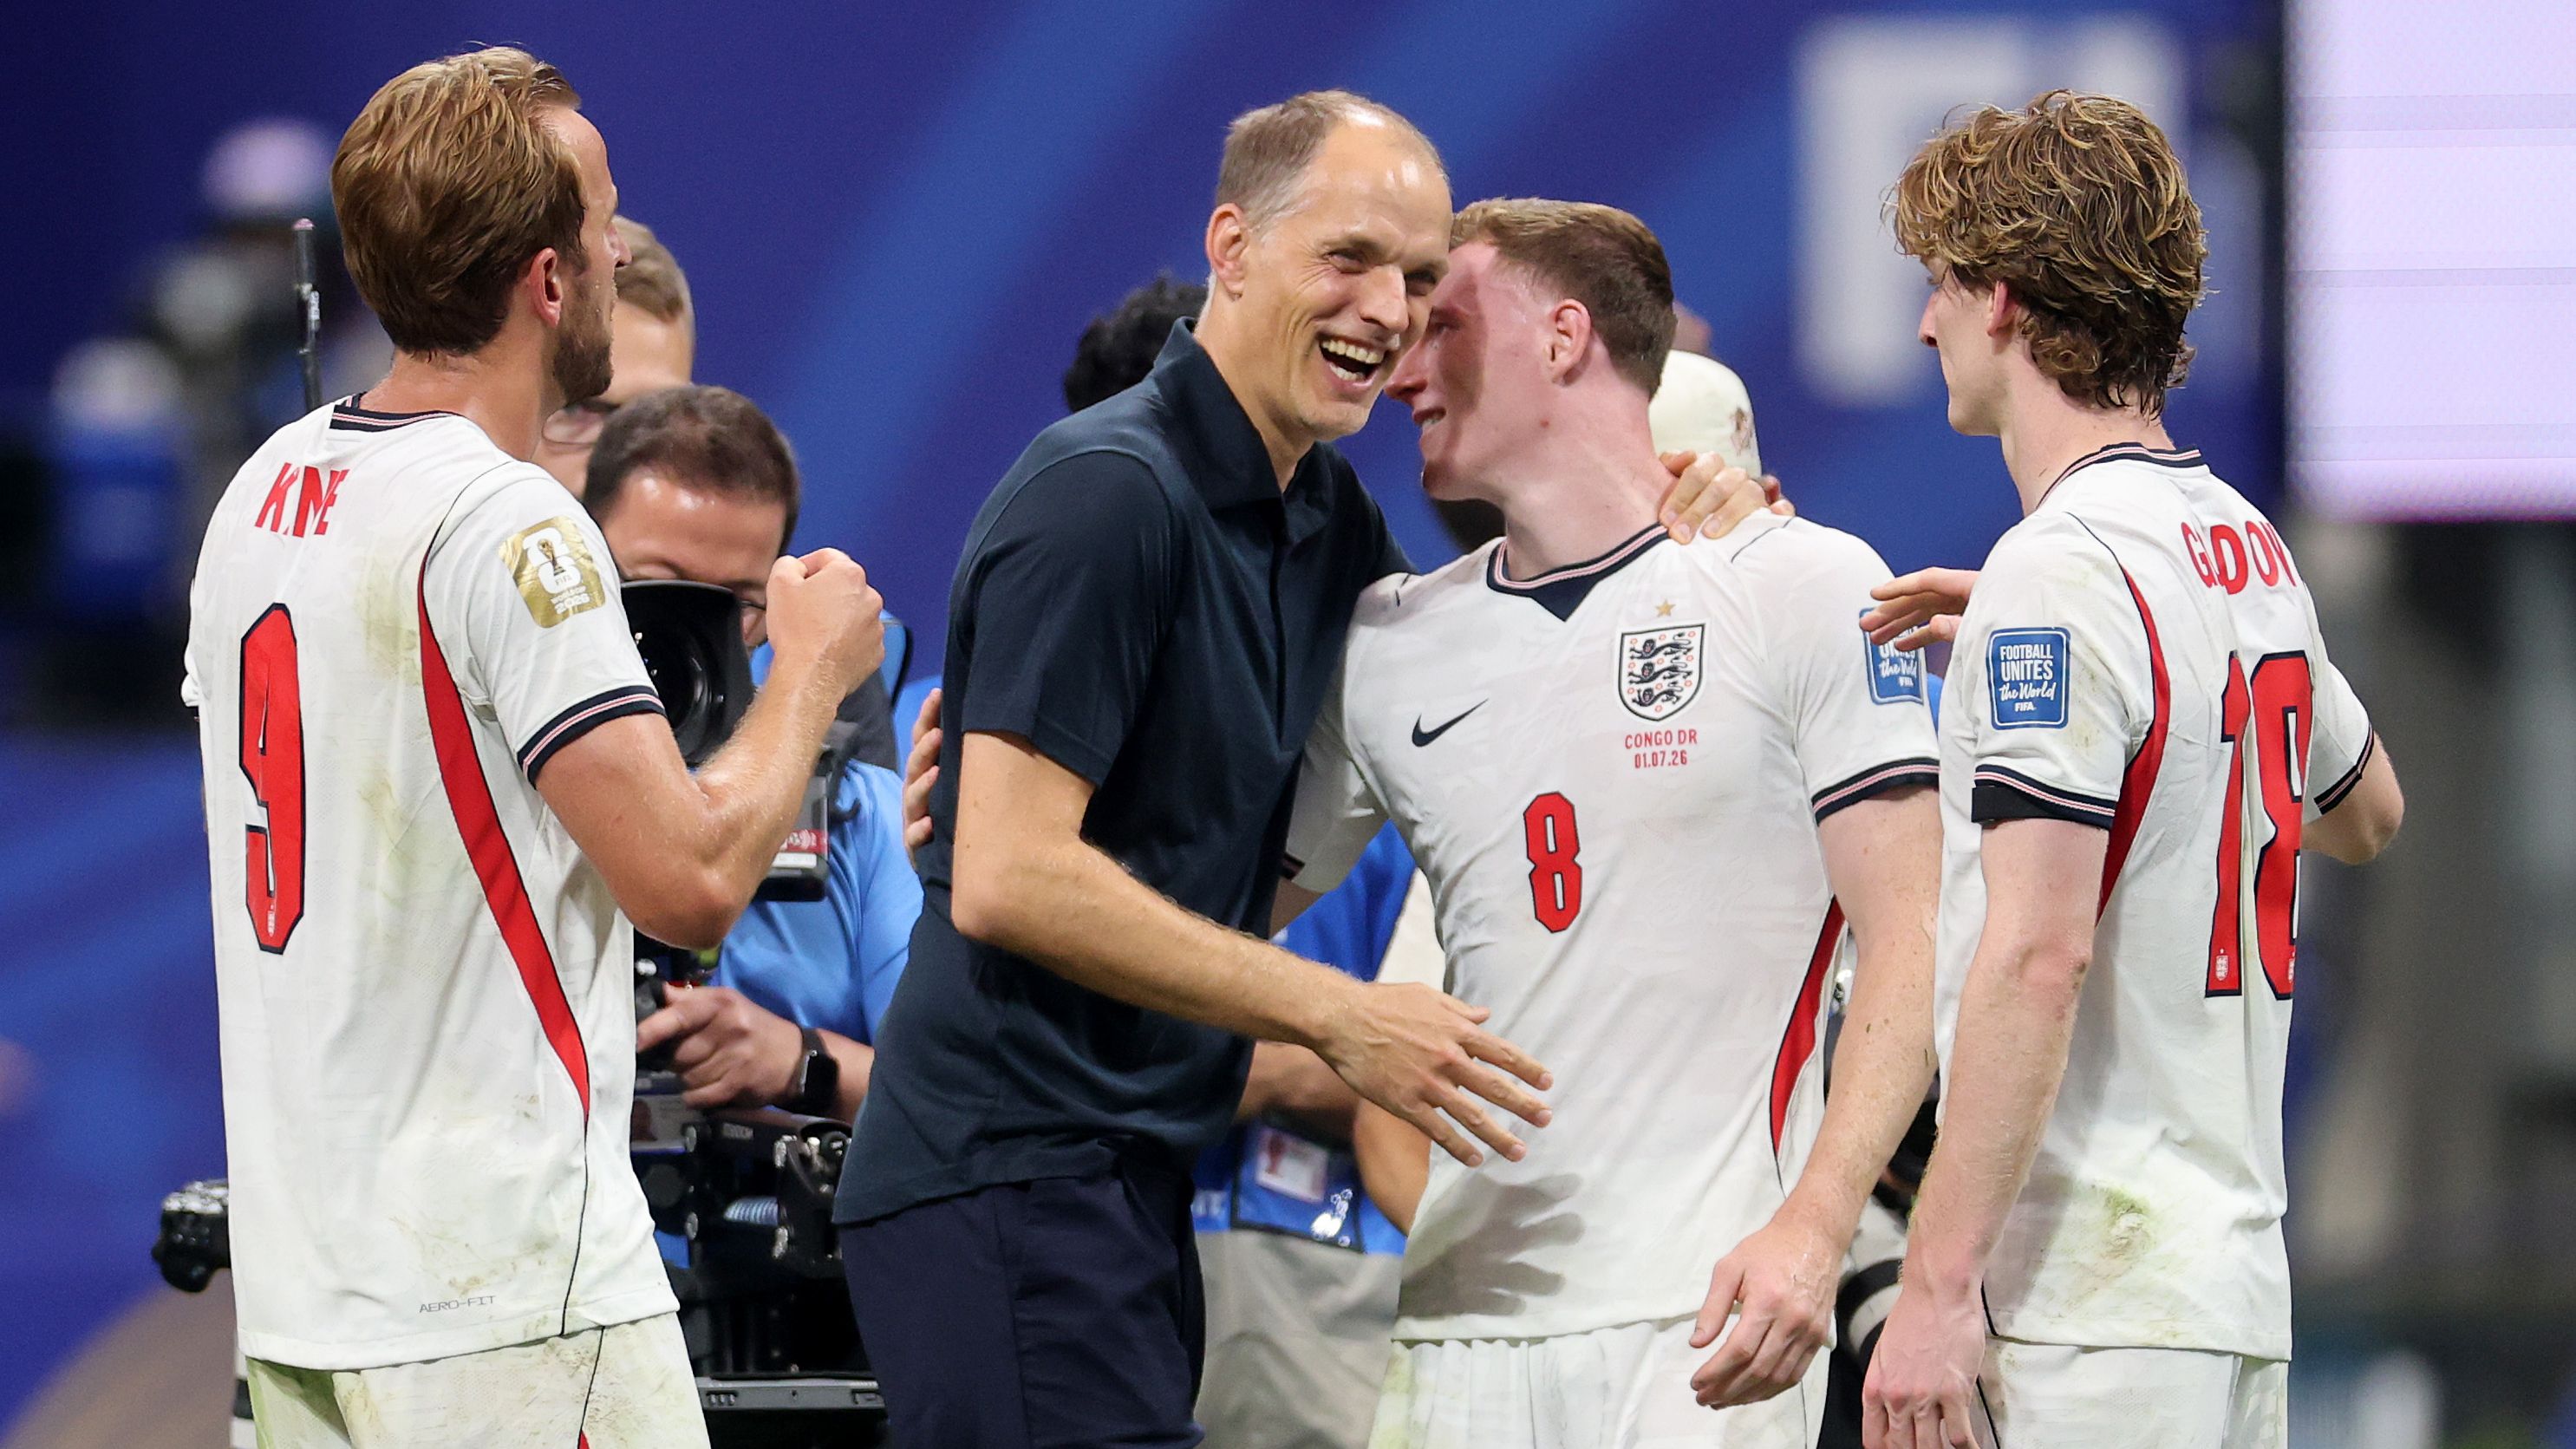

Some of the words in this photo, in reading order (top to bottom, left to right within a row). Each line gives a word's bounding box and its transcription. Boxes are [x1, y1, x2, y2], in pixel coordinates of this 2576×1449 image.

[254, 461, 350, 538] KNE
[1999, 643, 2053, 661] FOOTBALL
[2000, 659, 2053, 682] UNITES
[1999, 682, 2019, 702] the
[2019, 680, 2057, 701] World
[2014, 702, 2035, 712] FIFA
[1625, 730, 1673, 749] CONGO
[1678, 728, 1698, 745] DR
[1634, 749, 1688, 769] 01.07.26
[239, 603, 304, 955] 9
[2205, 650, 2315, 1001] 18
[1523, 791, 1582, 934] 8
[419, 1296, 497, 1314] AERO-FIT
